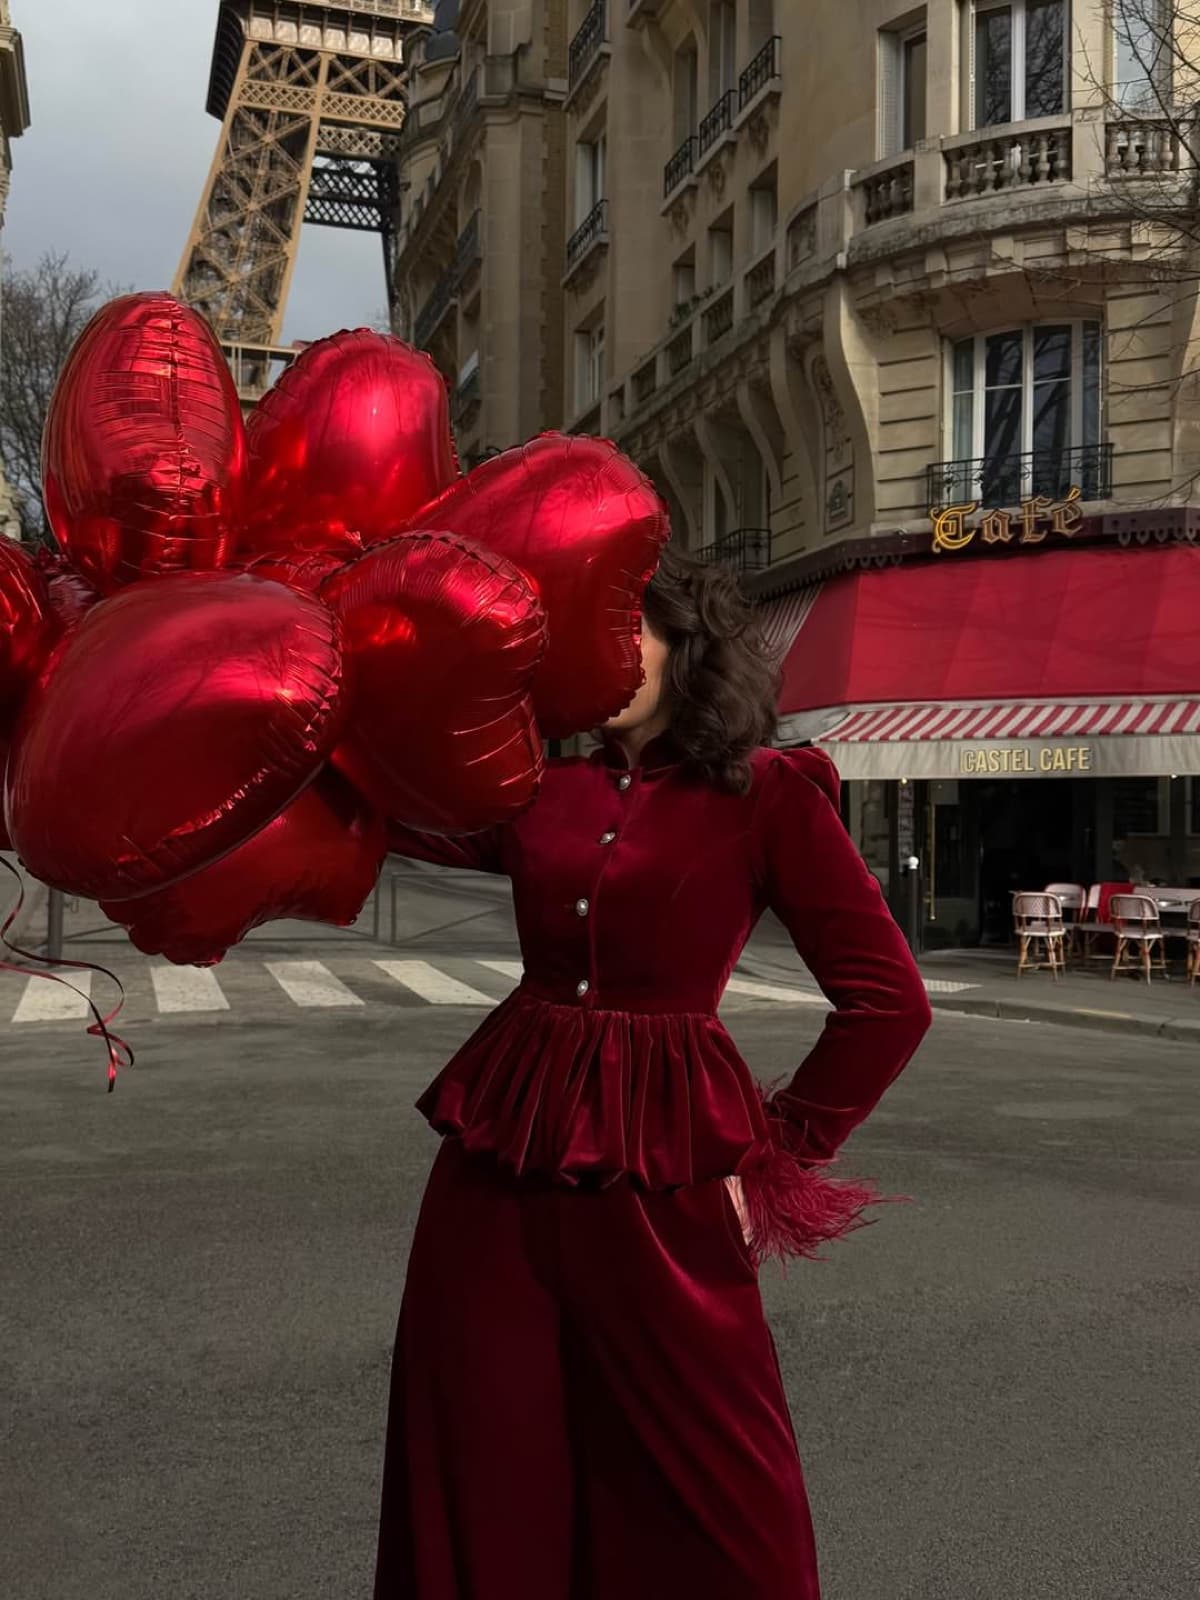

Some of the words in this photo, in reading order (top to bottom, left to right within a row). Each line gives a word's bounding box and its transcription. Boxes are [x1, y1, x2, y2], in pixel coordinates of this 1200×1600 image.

[930, 486, 1083, 553] Café
[962, 749, 1034, 773] CASTEL
[1040, 747, 1090, 771] CAFE
